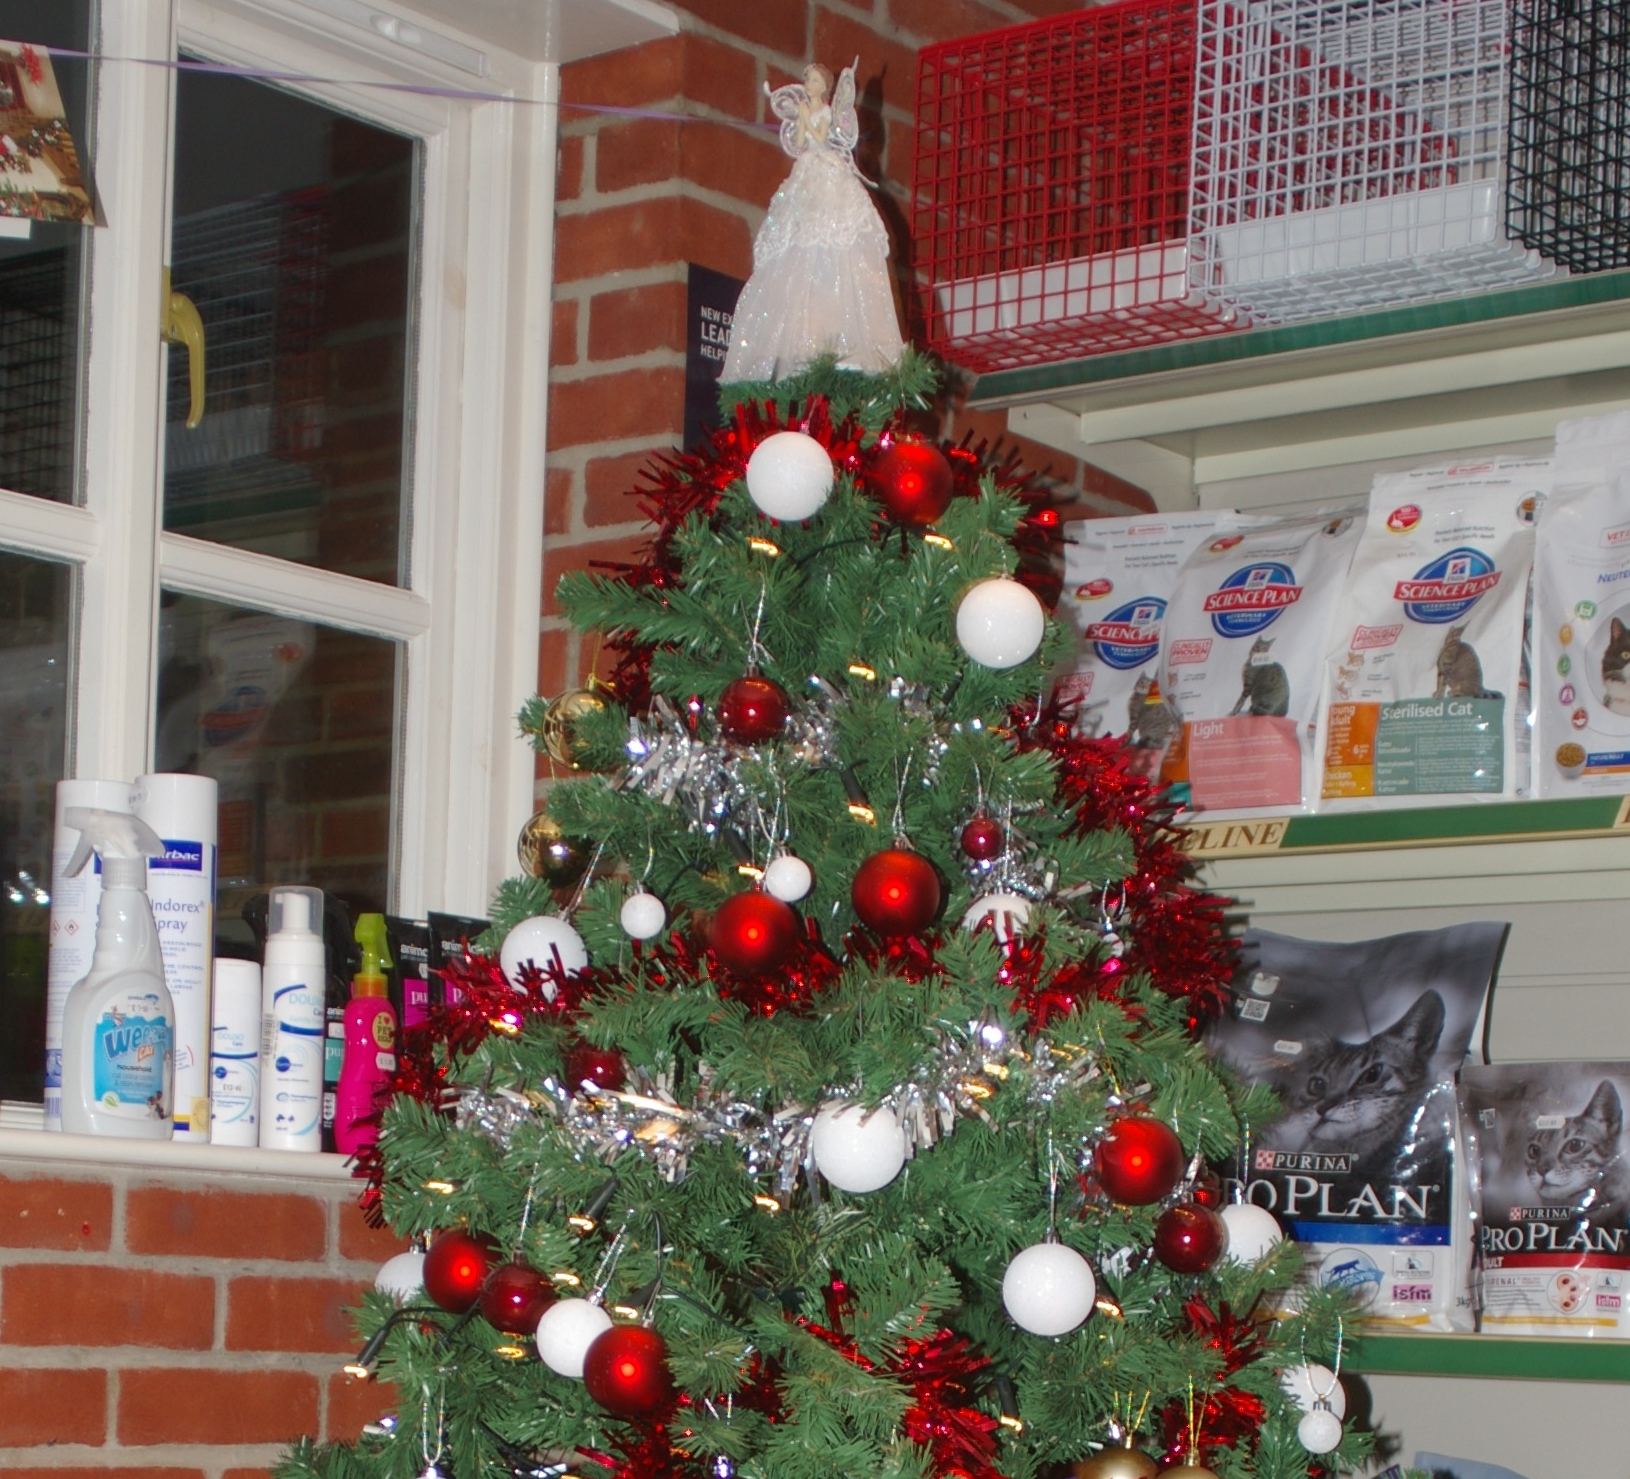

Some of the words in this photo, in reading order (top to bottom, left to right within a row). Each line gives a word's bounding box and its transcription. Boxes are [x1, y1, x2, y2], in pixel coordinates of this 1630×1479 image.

[701, 305, 720, 321] NEW
[1400, 583, 1461, 599] SCIENCE
[1462, 577, 1497, 595] PLAN
[1208, 590, 1261, 610] SCIENCE
[1262, 588, 1299, 605] PLAN
[1381, 702, 1443, 721] Sterilised
[1447, 702, 1473, 716] Cat
[1193, 721, 1224, 739] Light
[1174, 821, 1284, 851] ELINE
[1275, 1155, 1348, 1171] PURINA
[1283, 1175, 1433, 1219] PLAN
[1522, 1208, 1569, 1218] PURINA
[1482, 1225, 1524, 1251] PRO
[1526, 1222, 1626, 1252] PLAN
[1392, 1285, 1432, 1301] isfm
